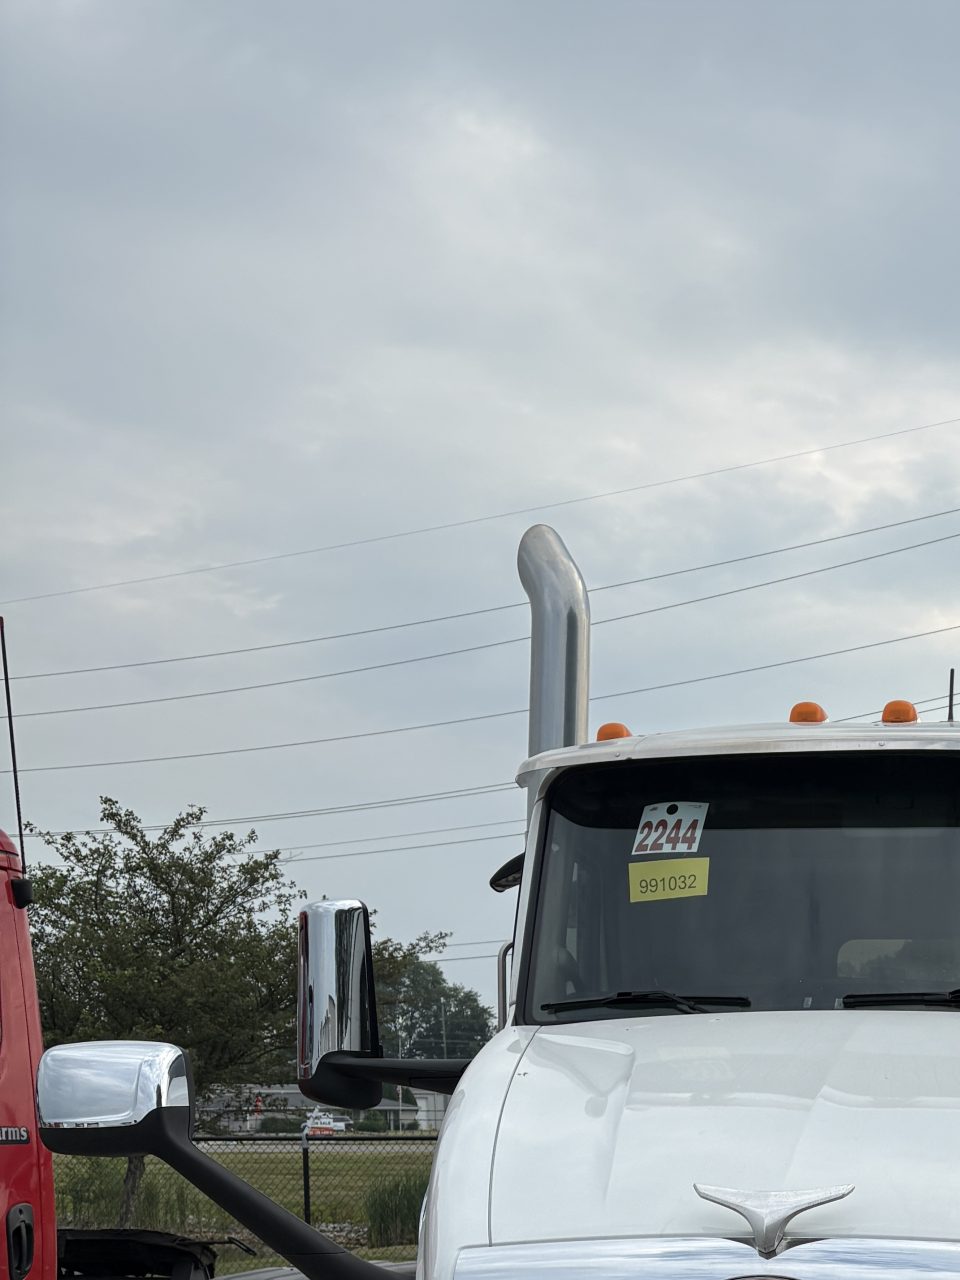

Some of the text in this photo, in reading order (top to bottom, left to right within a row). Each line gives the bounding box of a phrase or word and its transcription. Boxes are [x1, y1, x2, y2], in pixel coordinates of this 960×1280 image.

[635, 818, 699, 852] 2244
[639, 874, 697, 894] 991032
[0, 1127, 28, 1140] rms
